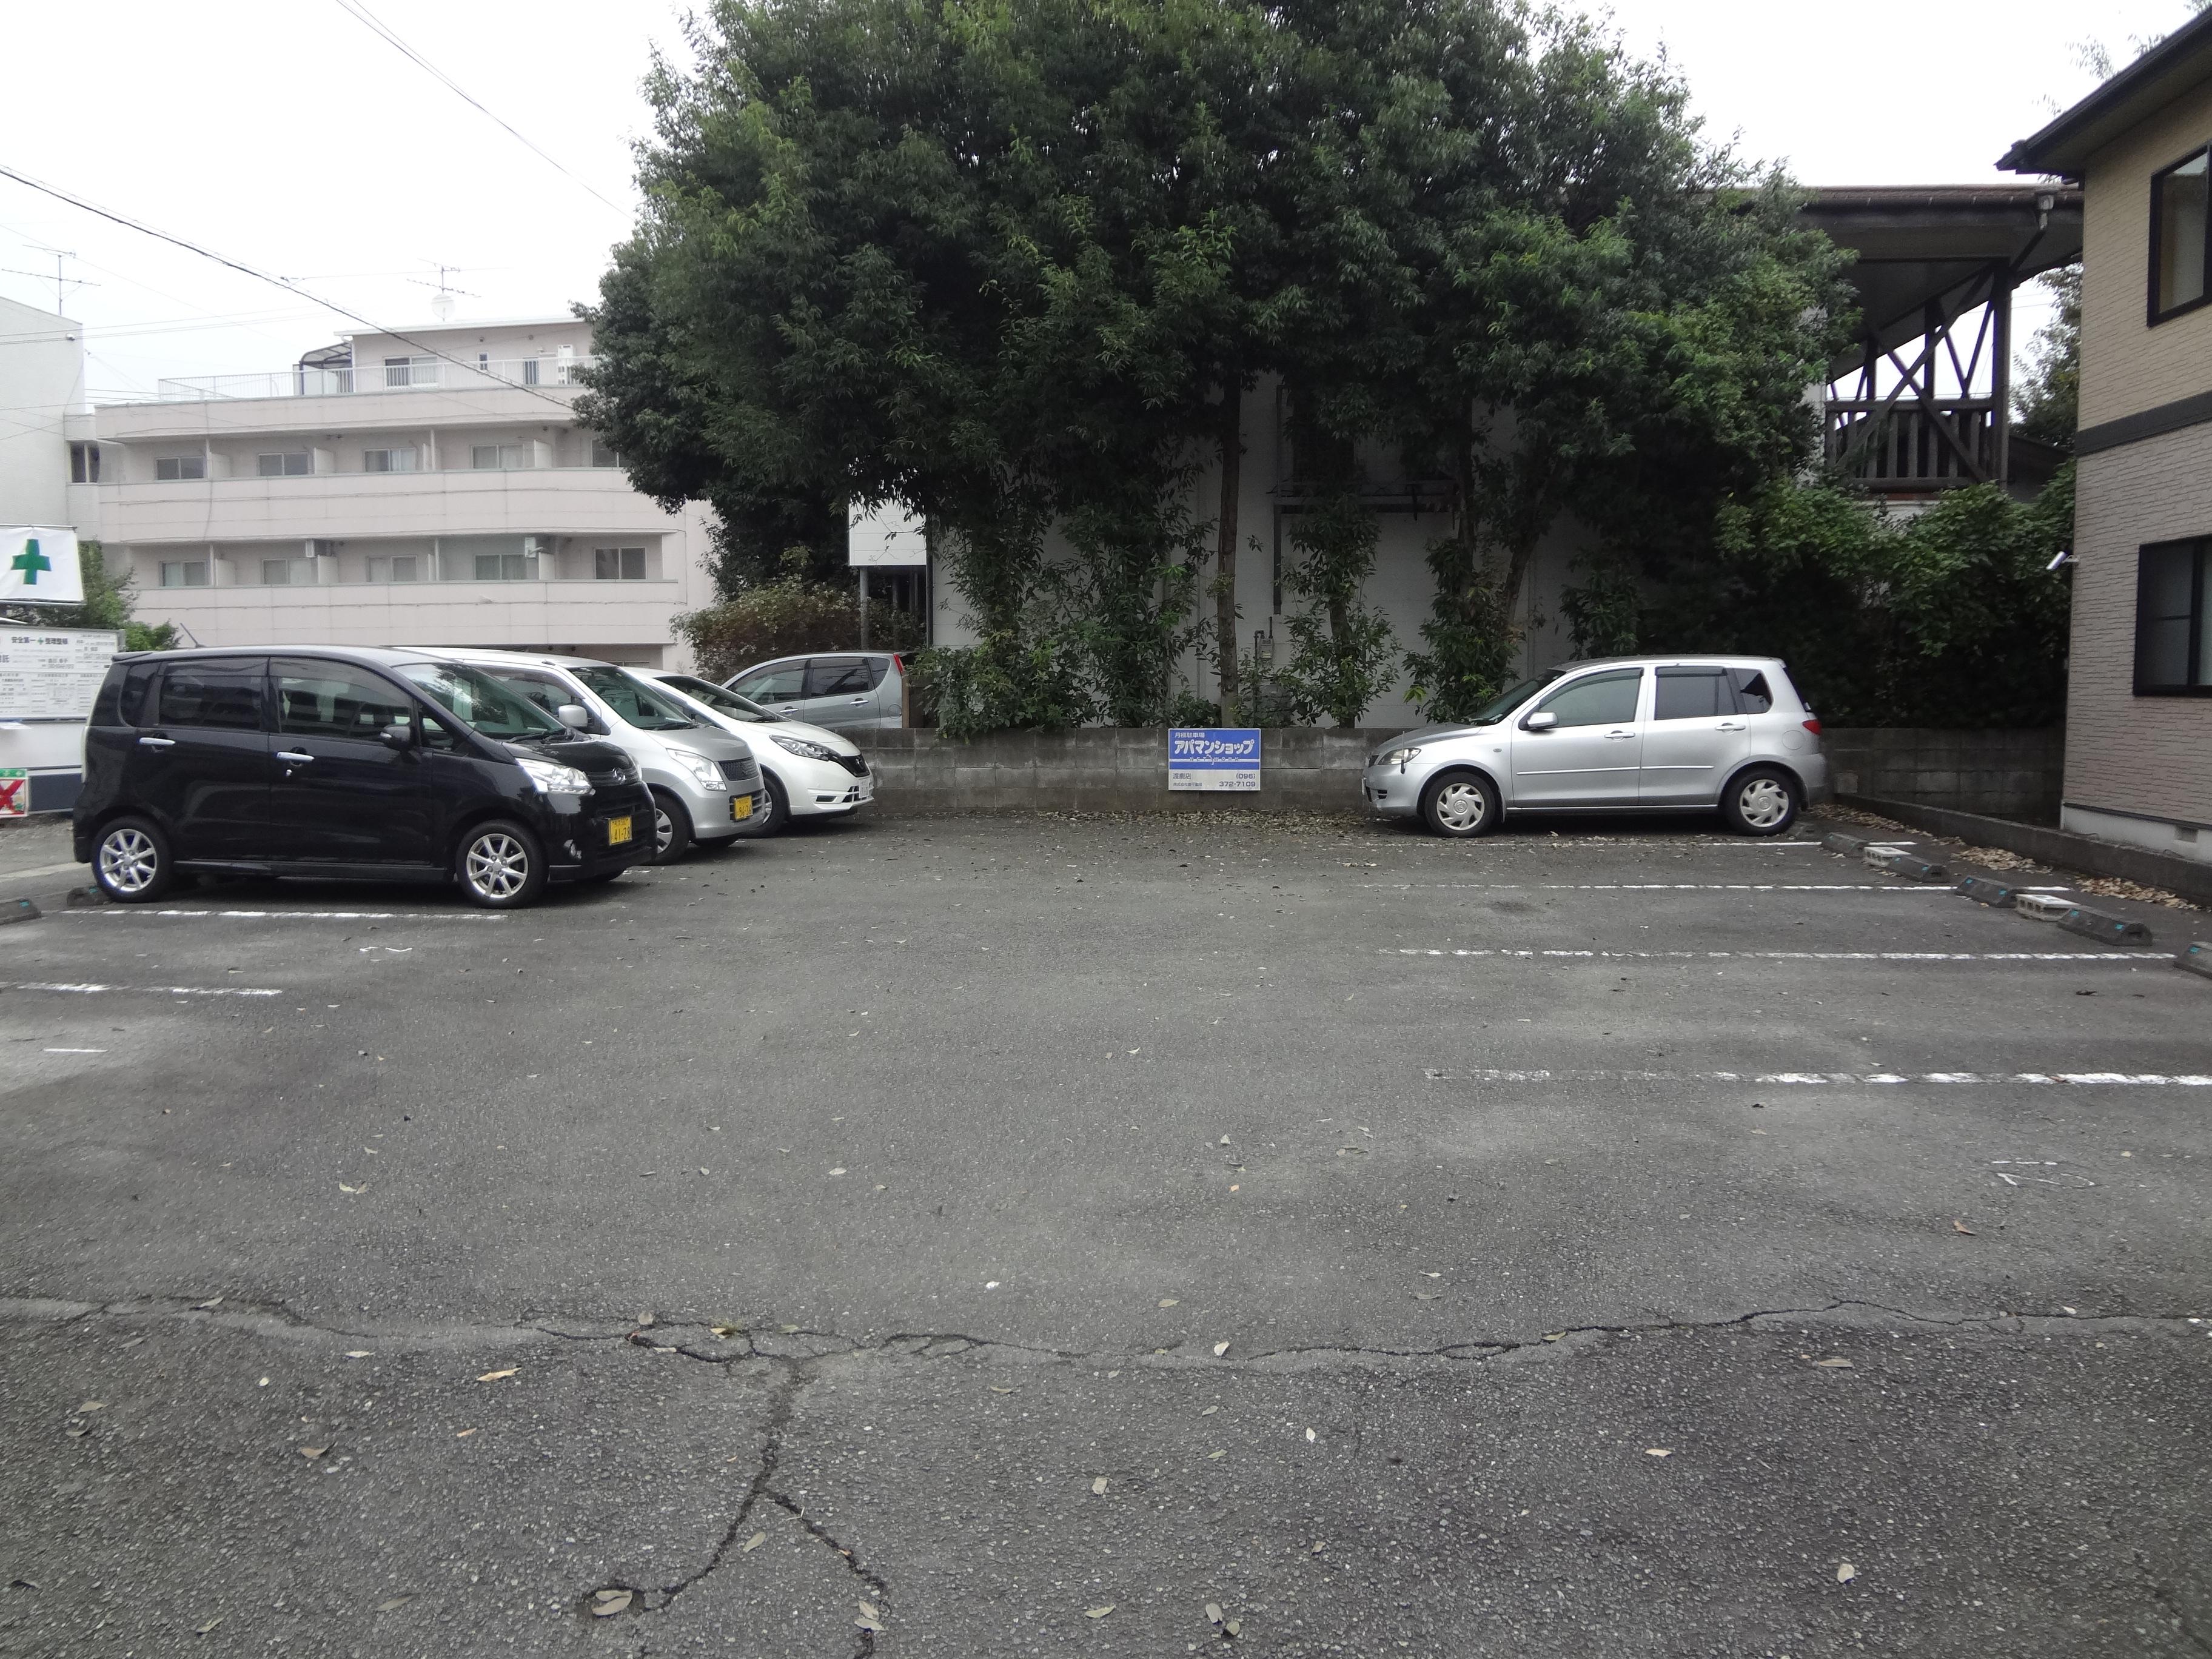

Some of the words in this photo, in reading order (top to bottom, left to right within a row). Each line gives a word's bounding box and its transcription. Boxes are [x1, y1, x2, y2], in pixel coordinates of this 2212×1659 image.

[1175, 739, 1254, 754] アパマンショップ
